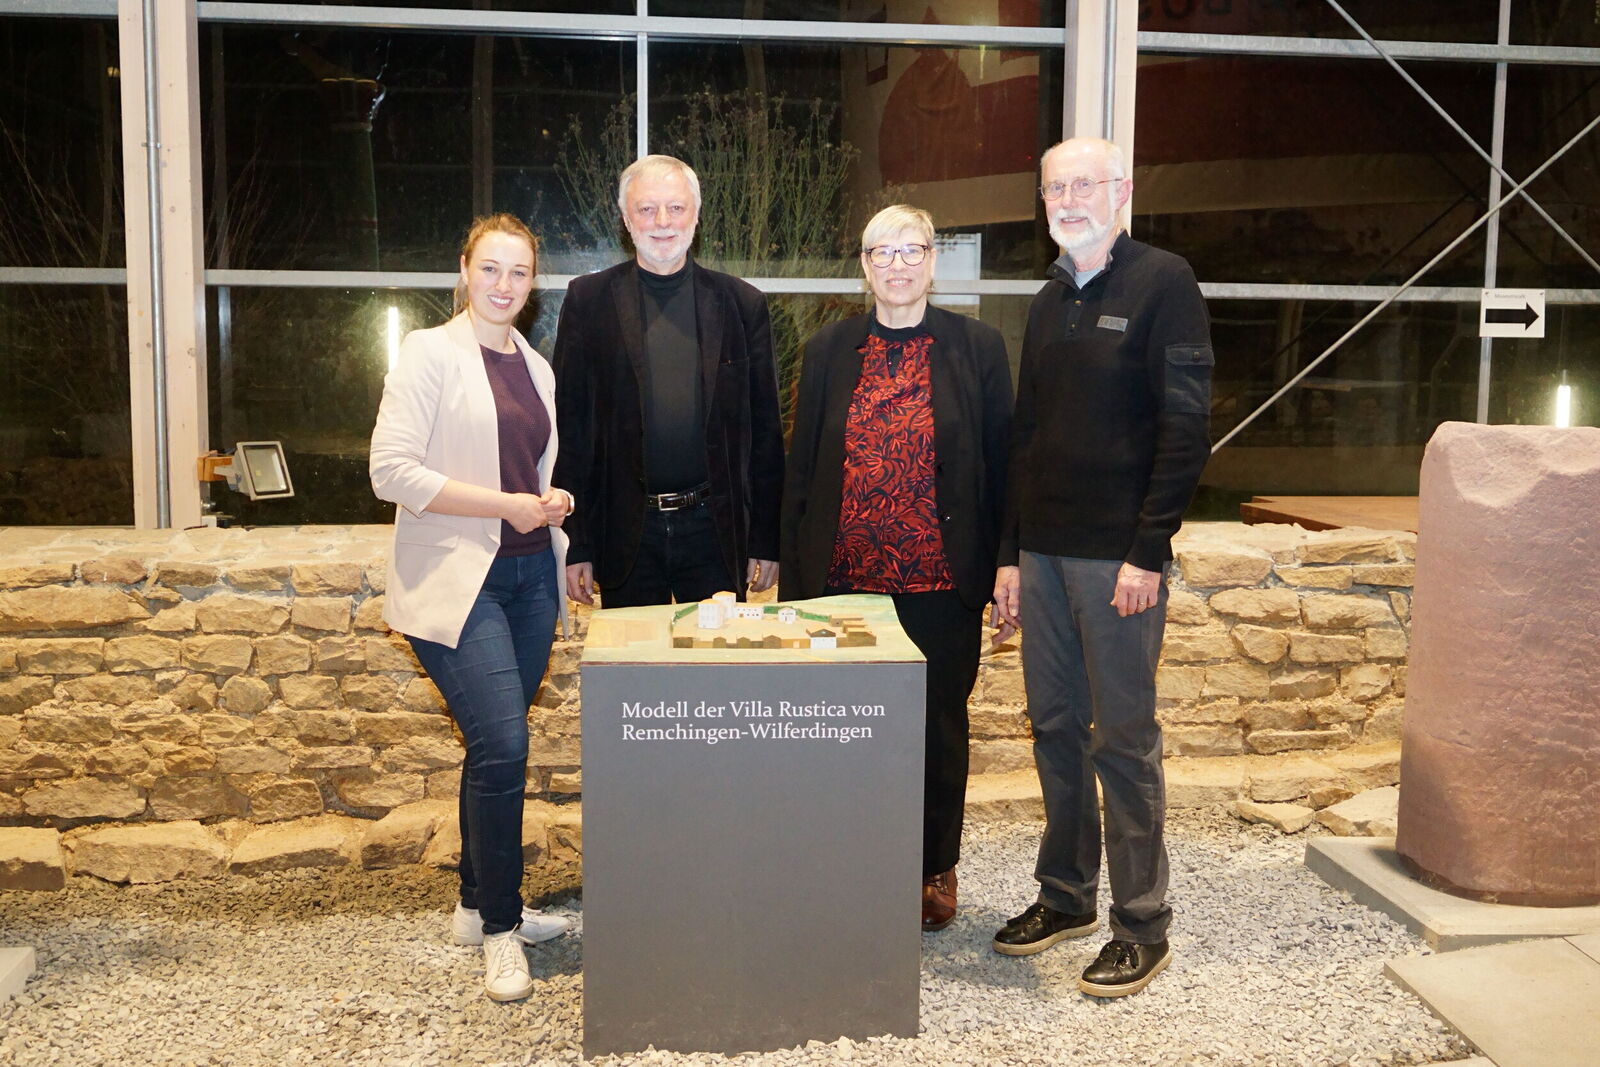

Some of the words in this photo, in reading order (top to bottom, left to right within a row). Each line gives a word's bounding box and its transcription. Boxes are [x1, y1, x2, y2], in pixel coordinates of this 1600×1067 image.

[622, 701, 688, 718] Modell
[694, 701, 725, 718] der
[729, 701, 773, 717] Villa
[779, 701, 846, 717] Rustica
[851, 704, 885, 717] von
[622, 722, 872, 744] Remchingen-Wilferdingen
